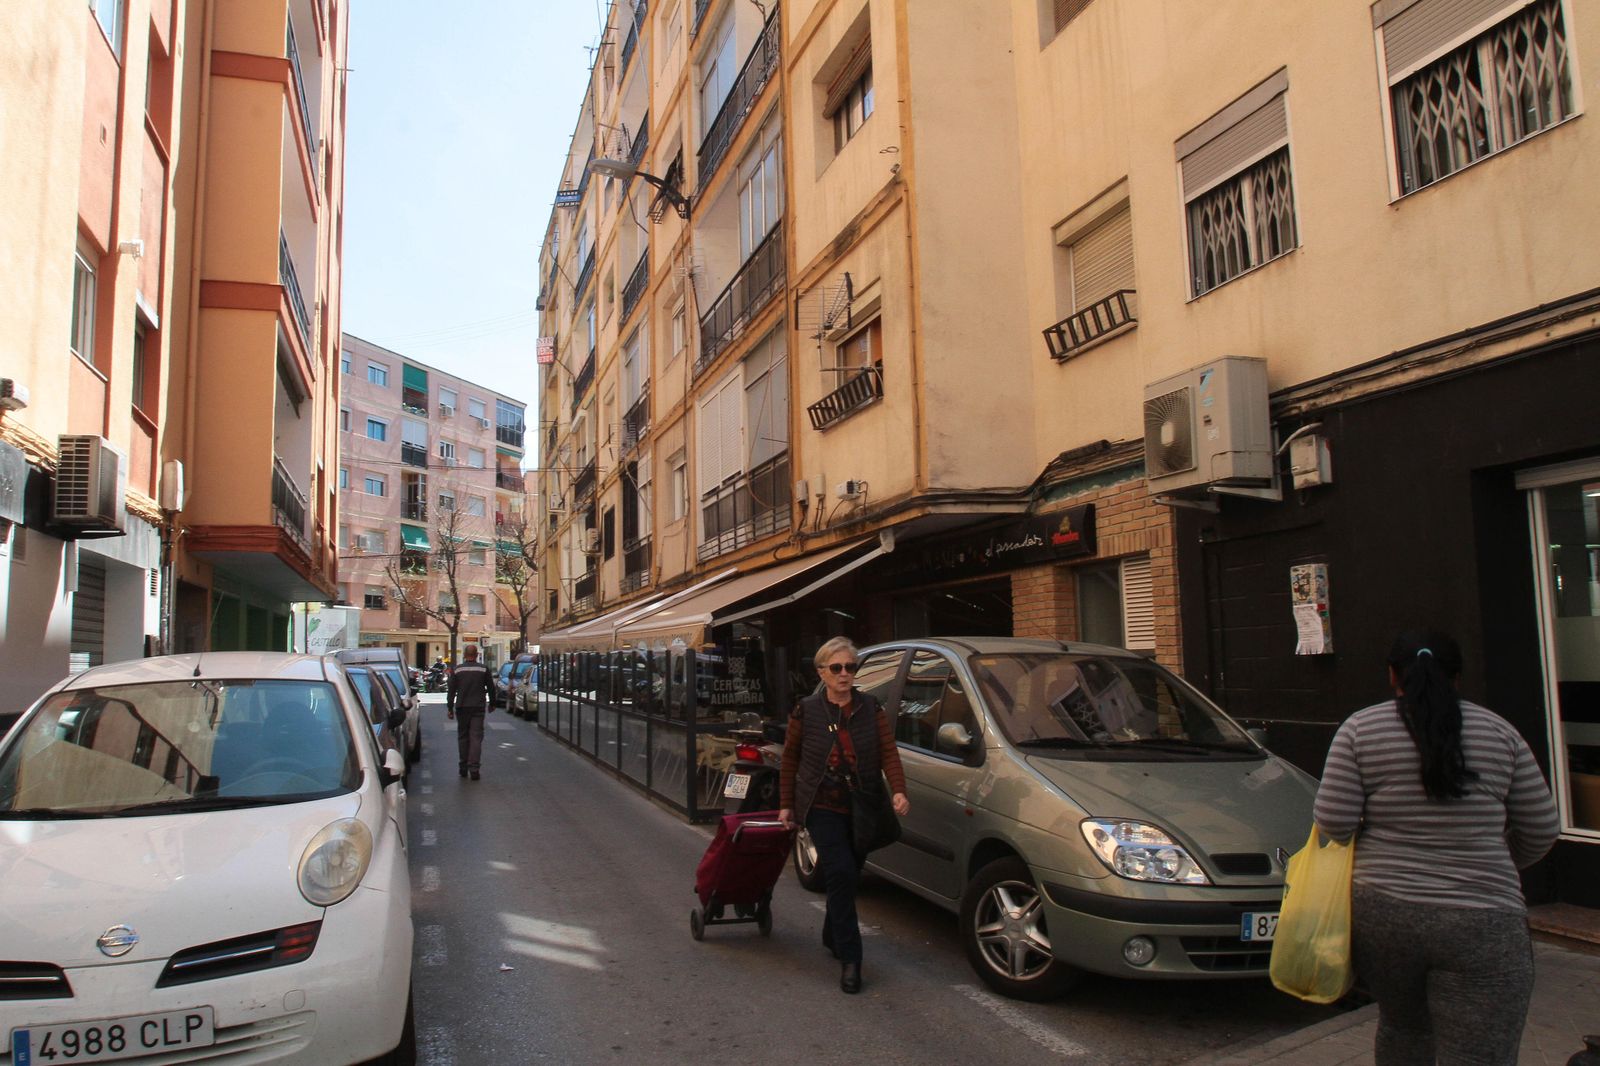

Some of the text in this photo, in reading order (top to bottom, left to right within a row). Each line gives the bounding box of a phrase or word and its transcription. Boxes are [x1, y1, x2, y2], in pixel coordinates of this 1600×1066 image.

[710, 691, 765, 705] ALHAMBRA
[39, 1014, 204, 1060] 4988 CLP
[18, 1052, 26, 1062] E
